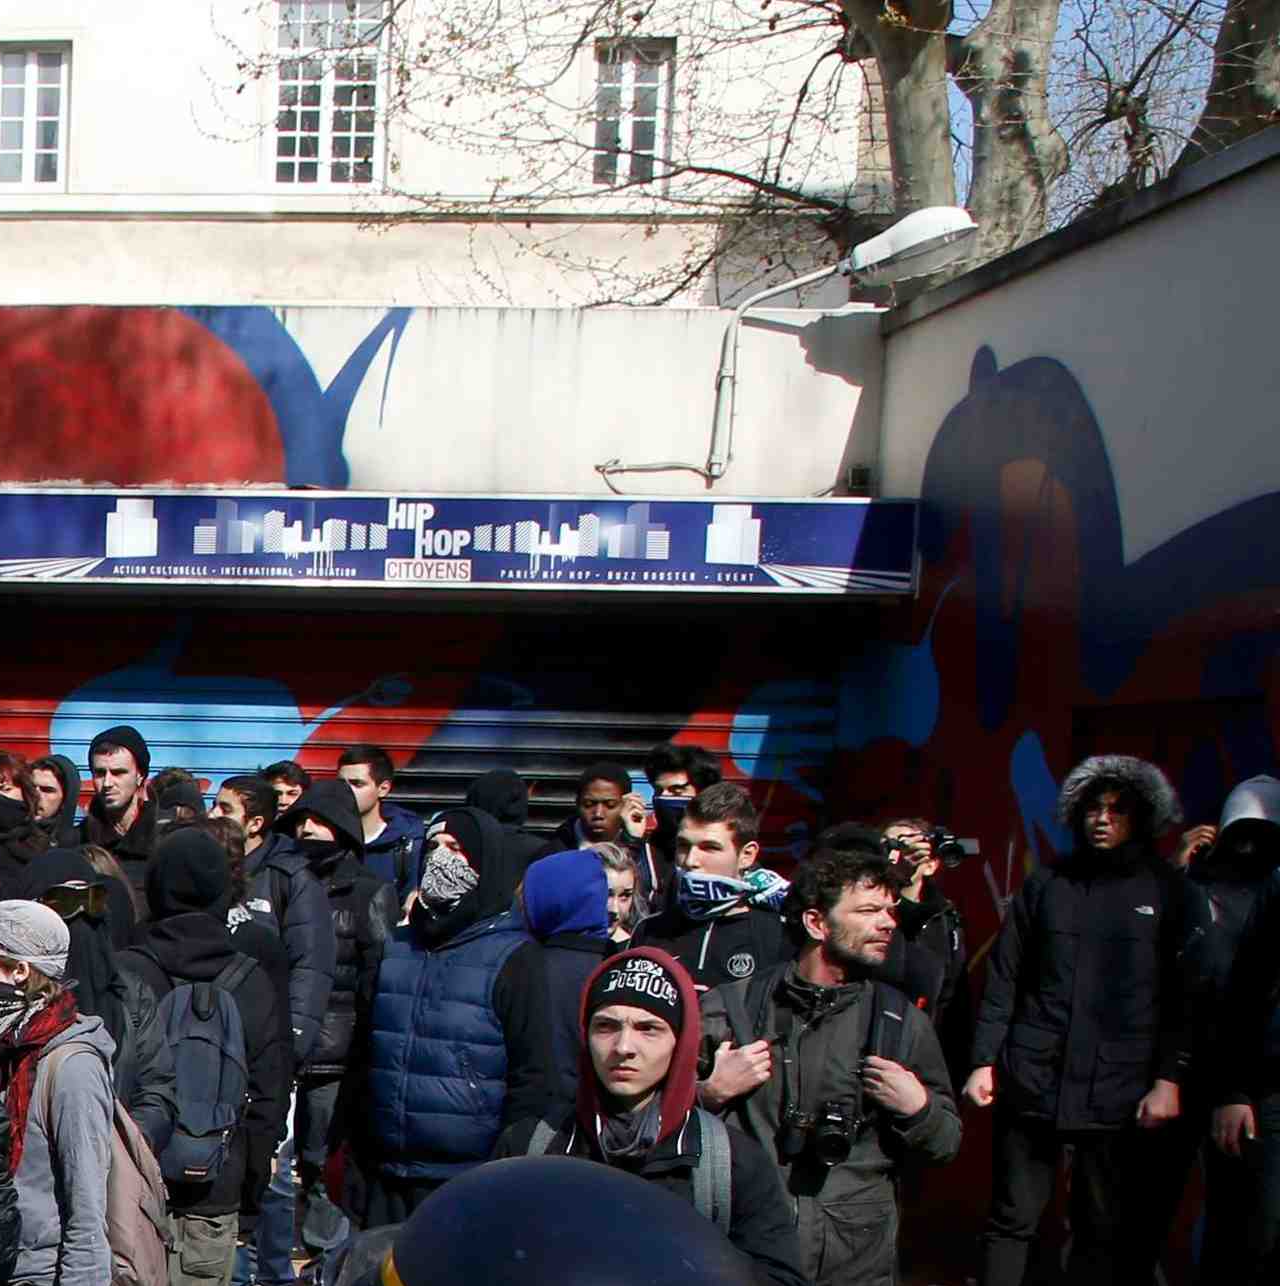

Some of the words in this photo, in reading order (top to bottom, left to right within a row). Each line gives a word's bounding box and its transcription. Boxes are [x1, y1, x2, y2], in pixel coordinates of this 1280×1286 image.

[388, 498, 434, 530] HIP
[418, 529, 471, 556] HOP
[387, 561, 470, 580] CITOYENS
